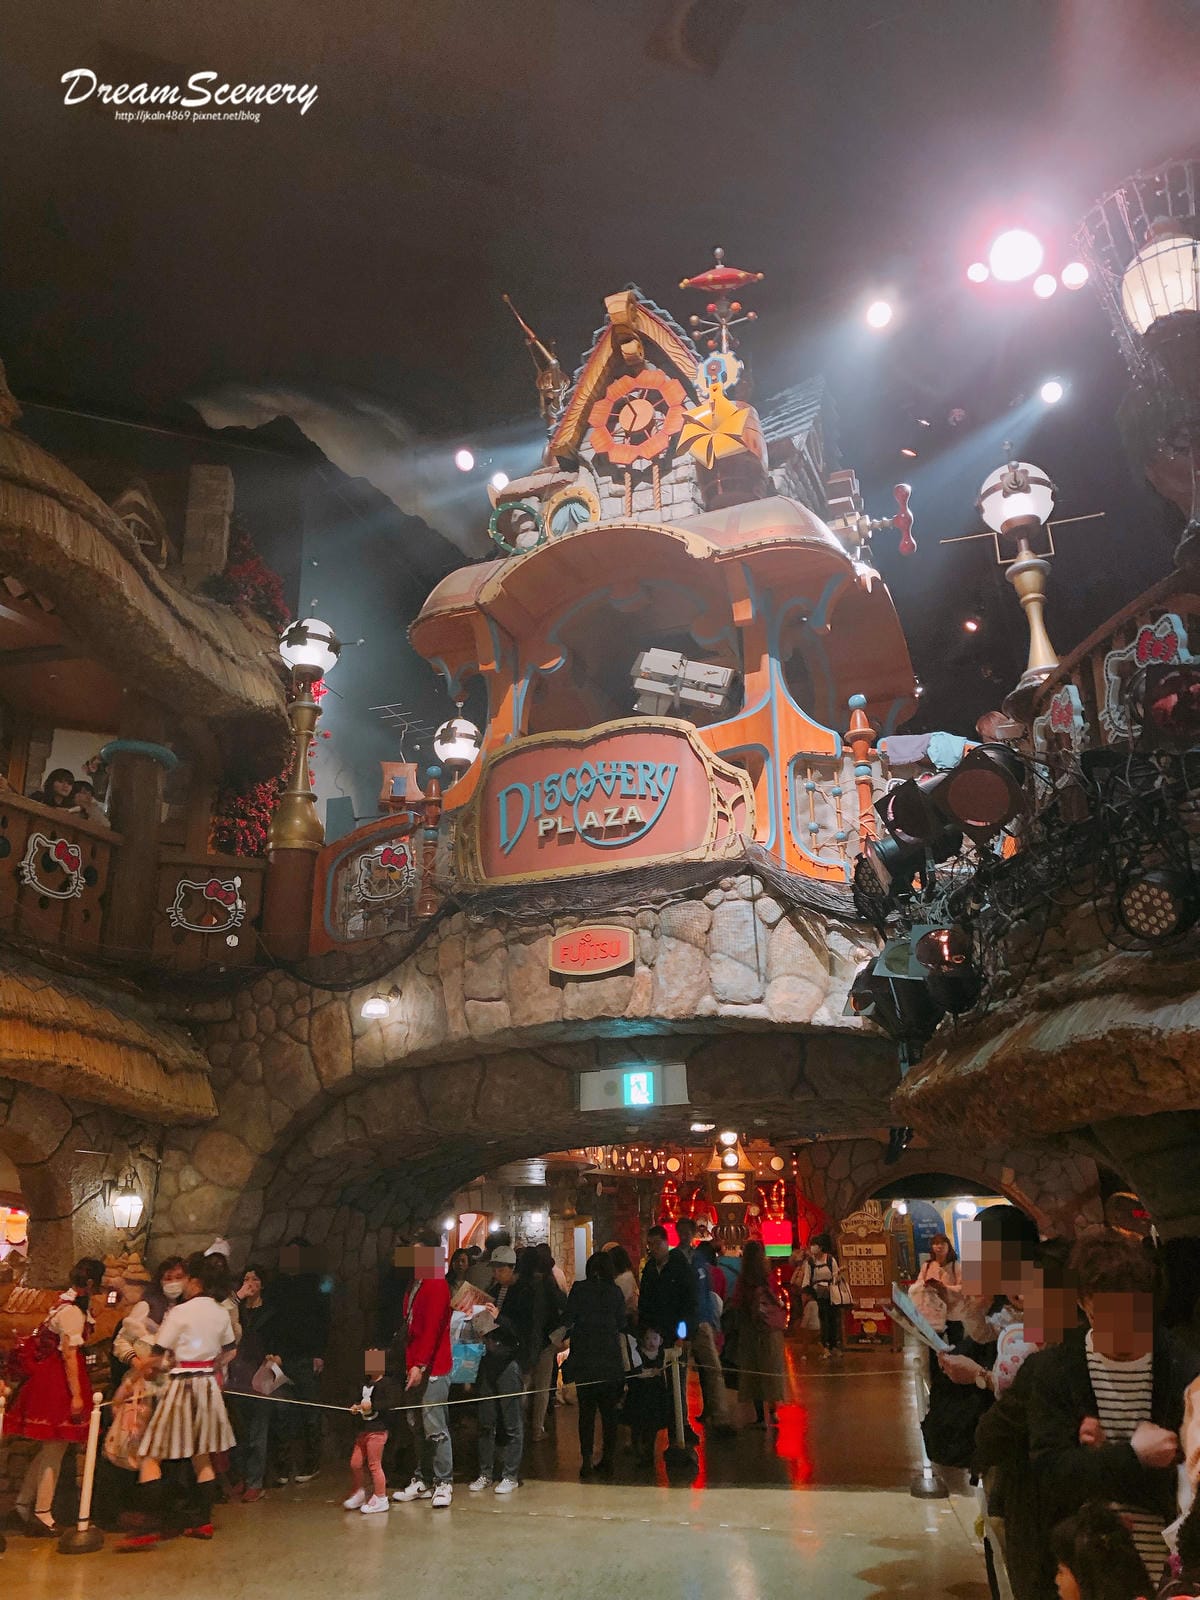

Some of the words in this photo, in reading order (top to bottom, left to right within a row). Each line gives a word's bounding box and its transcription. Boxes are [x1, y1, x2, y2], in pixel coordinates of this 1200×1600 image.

[497, 760, 678, 855] DISCOVERY
[538, 804, 643, 837] PLAZA
[560, 940, 621, 966] FUJITSU
